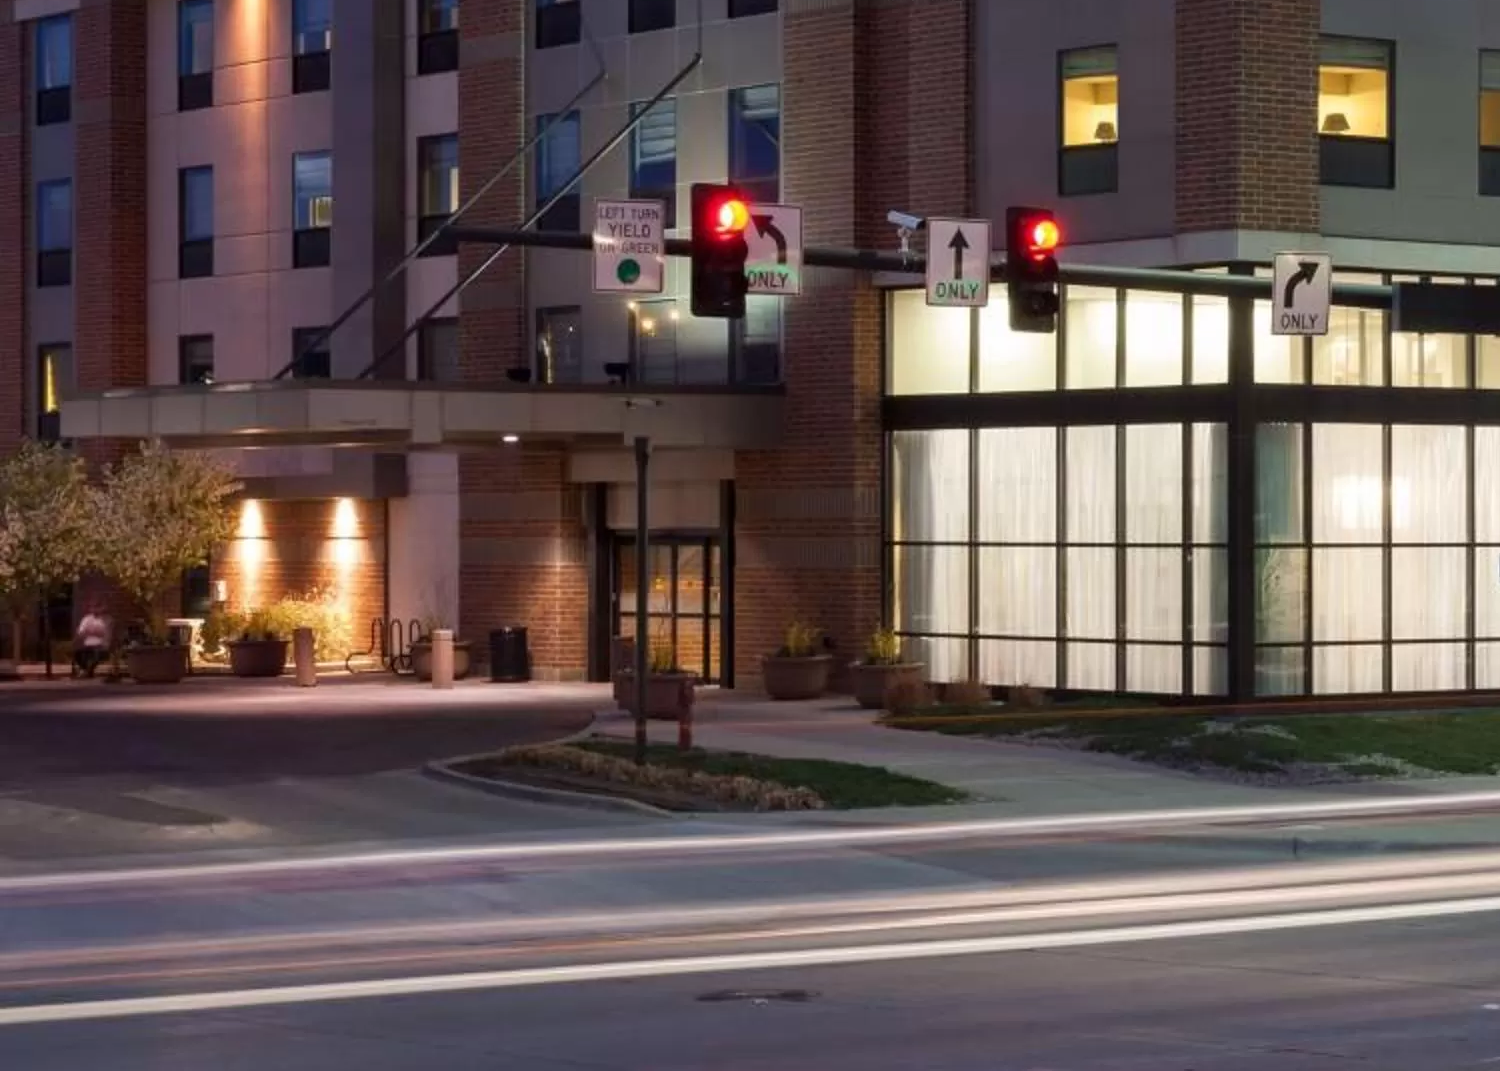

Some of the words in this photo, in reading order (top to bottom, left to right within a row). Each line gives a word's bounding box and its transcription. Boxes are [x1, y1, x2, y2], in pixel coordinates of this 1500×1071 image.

[599, 206, 626, 220] LEFT
[630, 207, 659, 221] TURN
[607, 224, 651, 238] YIELD
[600, 242, 616, 253] ON
[621, 242, 659, 254] GREEN
[747, 270, 789, 289] ONLY
[936, 282, 979, 300] ONLY
[1280, 313, 1319, 330] ONLY
